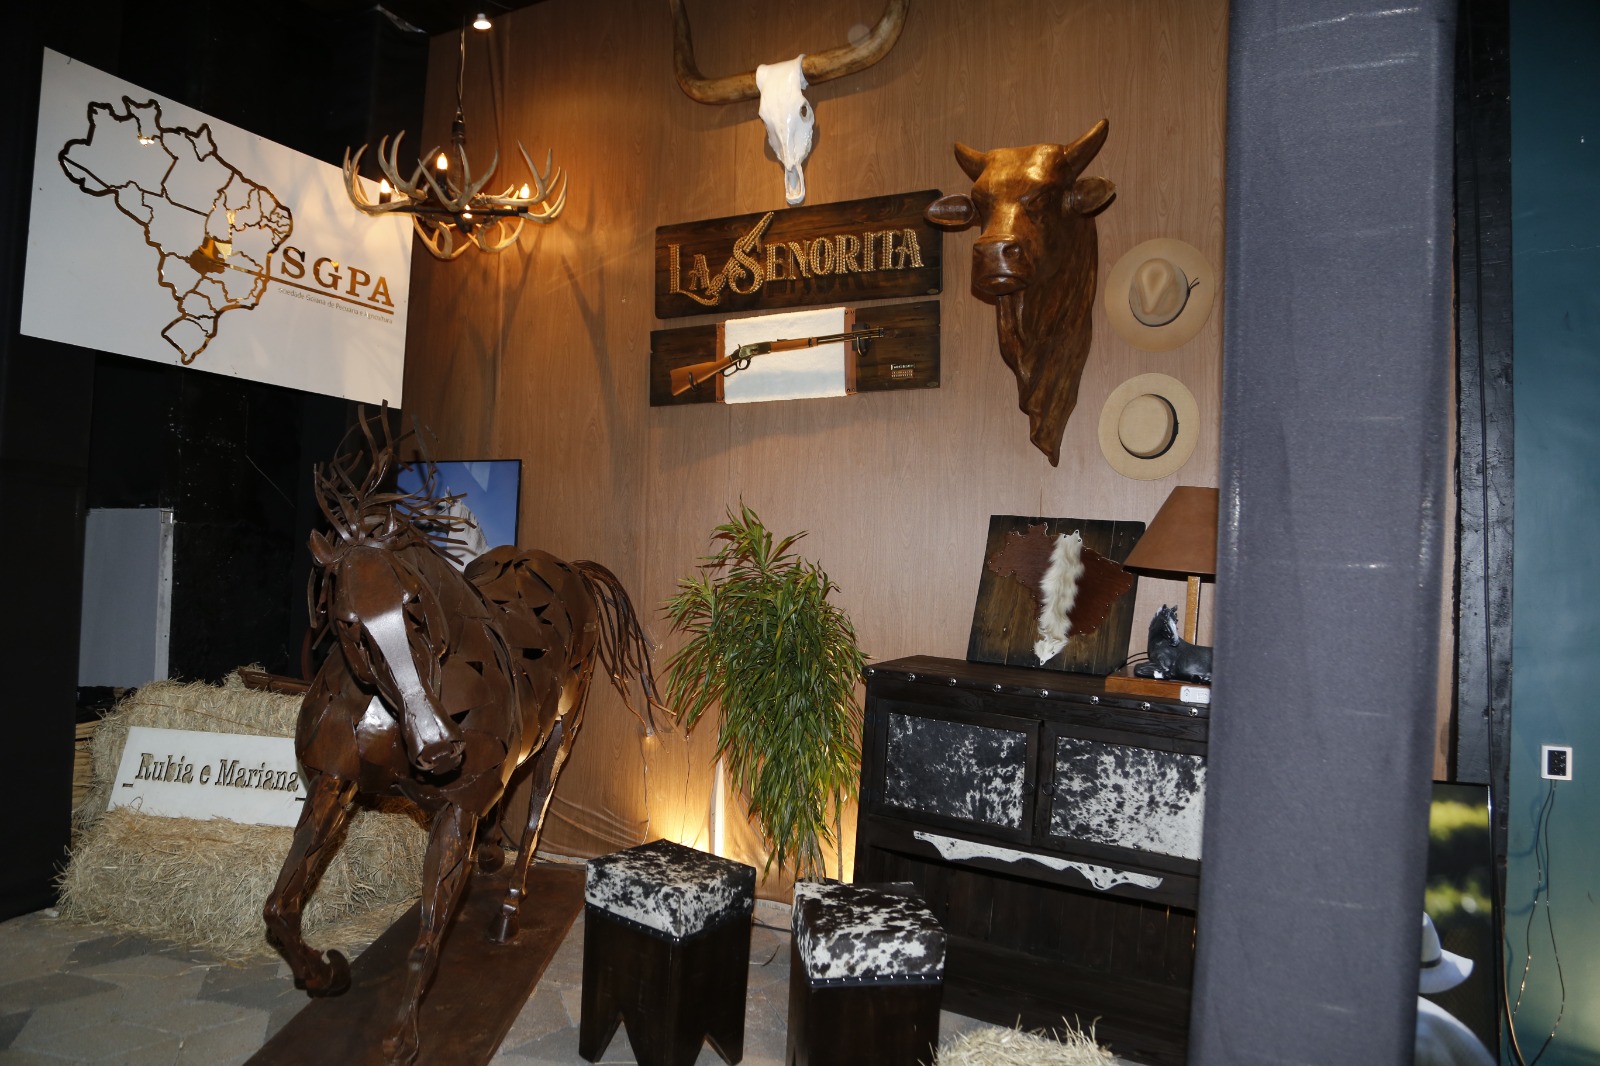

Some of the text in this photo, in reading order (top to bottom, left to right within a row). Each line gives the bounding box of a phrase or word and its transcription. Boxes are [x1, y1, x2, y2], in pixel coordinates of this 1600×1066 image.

[281, 246, 394, 307] SGPA
[668, 211, 924, 306] LA SENORITA
[199, 764, 212, 785] e
